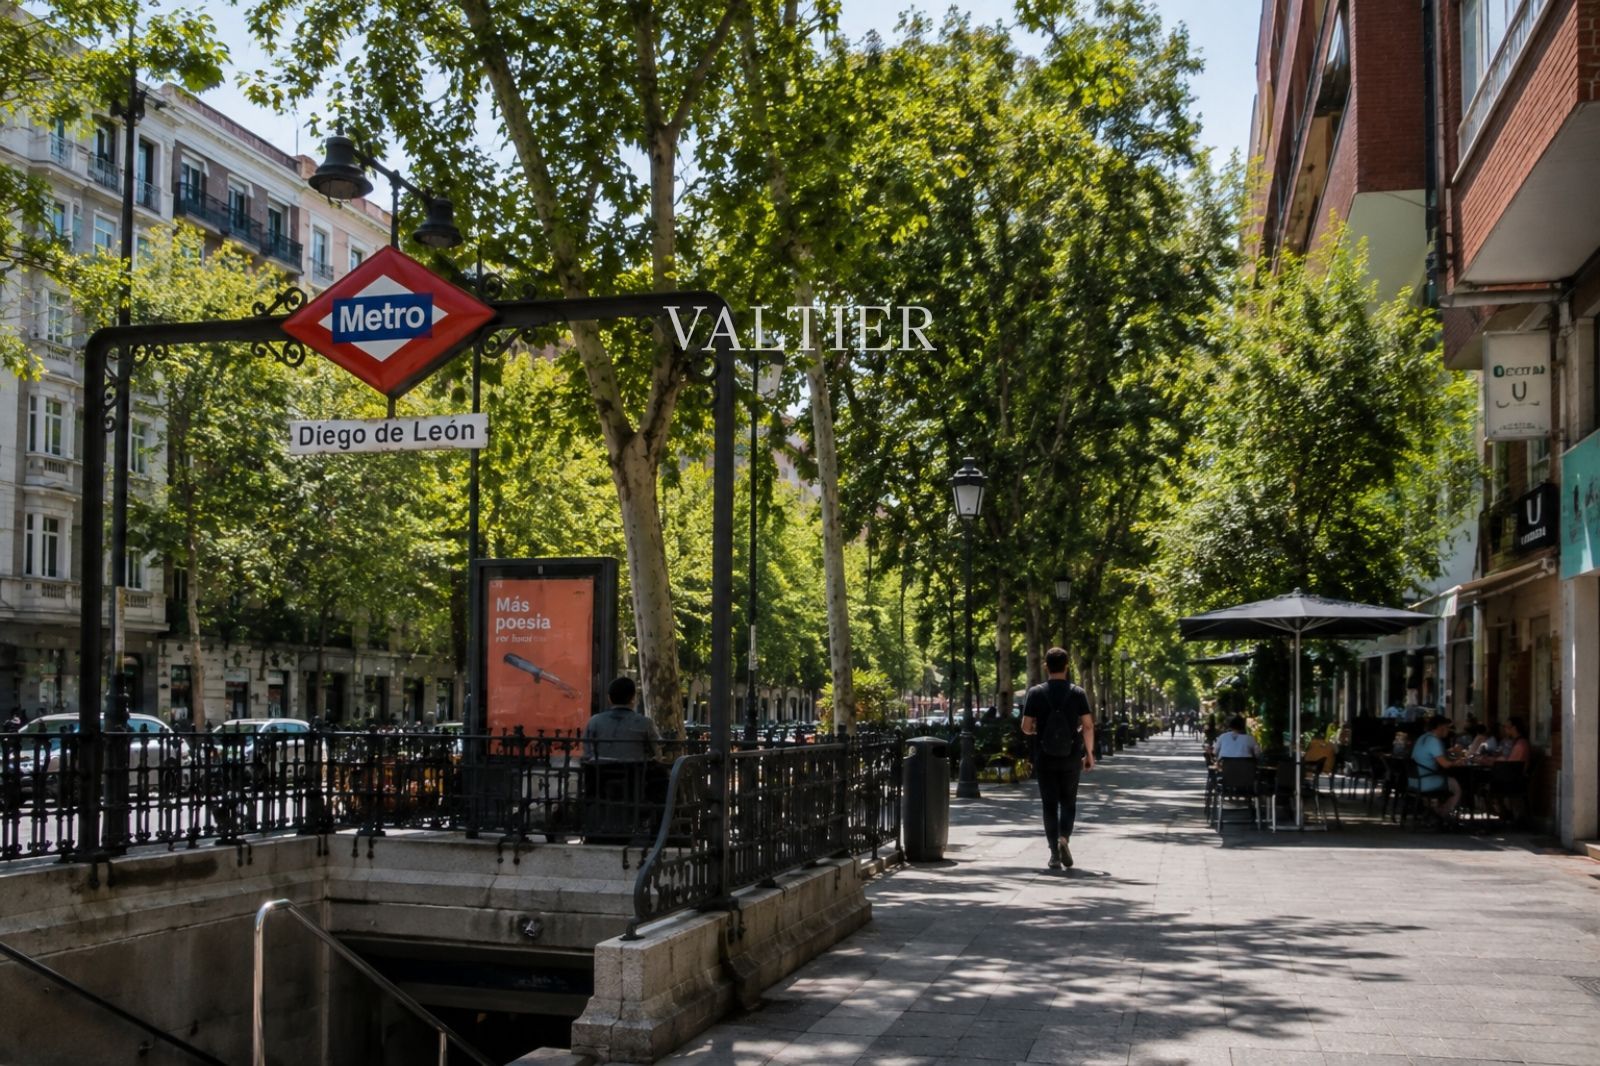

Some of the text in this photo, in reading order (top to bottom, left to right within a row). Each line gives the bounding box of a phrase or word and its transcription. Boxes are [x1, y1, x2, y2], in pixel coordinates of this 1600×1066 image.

[339, 303, 425, 333] Metro
[300, 420, 475, 450] Diego de León
[496, 595, 530, 612] Más
